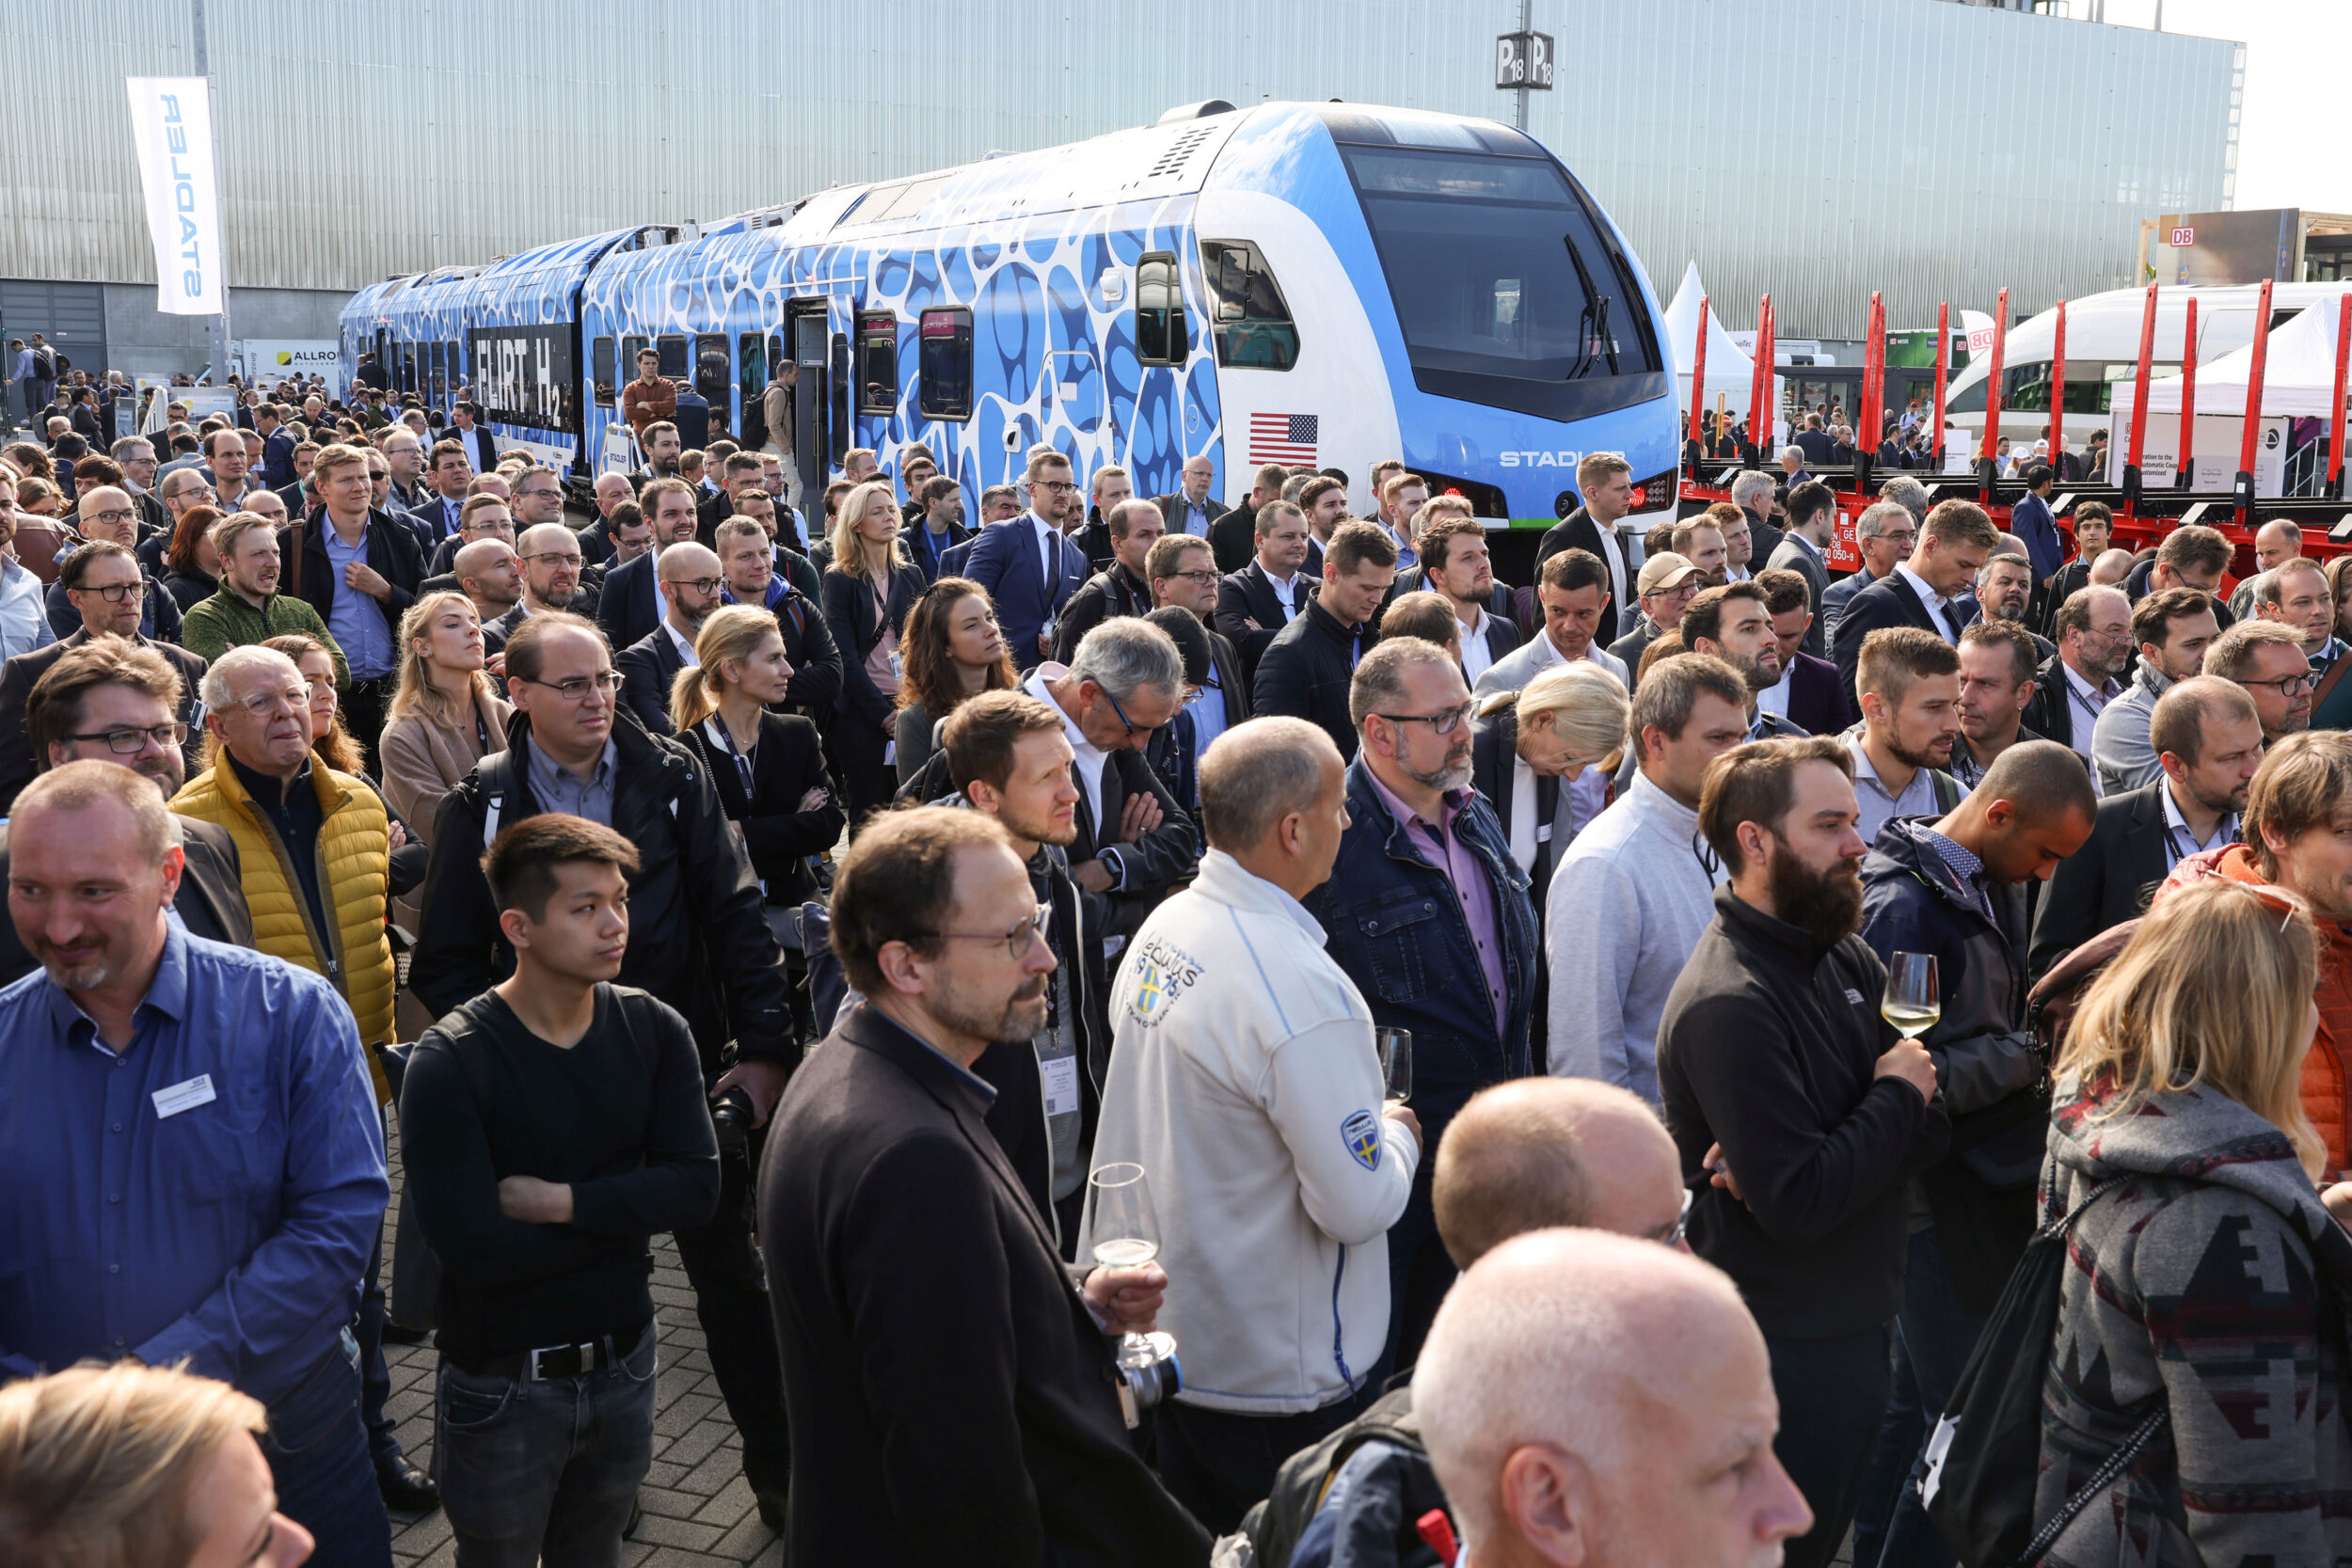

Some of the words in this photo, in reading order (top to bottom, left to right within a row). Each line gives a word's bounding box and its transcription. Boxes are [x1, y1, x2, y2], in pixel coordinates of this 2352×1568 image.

[2172, 229, 2192, 245] DB
[1957, 341, 1966, 350] DB
[294, 351, 340, 360] ALLRO
[477, 339, 527, 412] FLIRT
[1500, 451, 1625, 467] STAD
[1843, 530, 1854, 540] GE
[1833, 549, 1854, 562] 050-9
